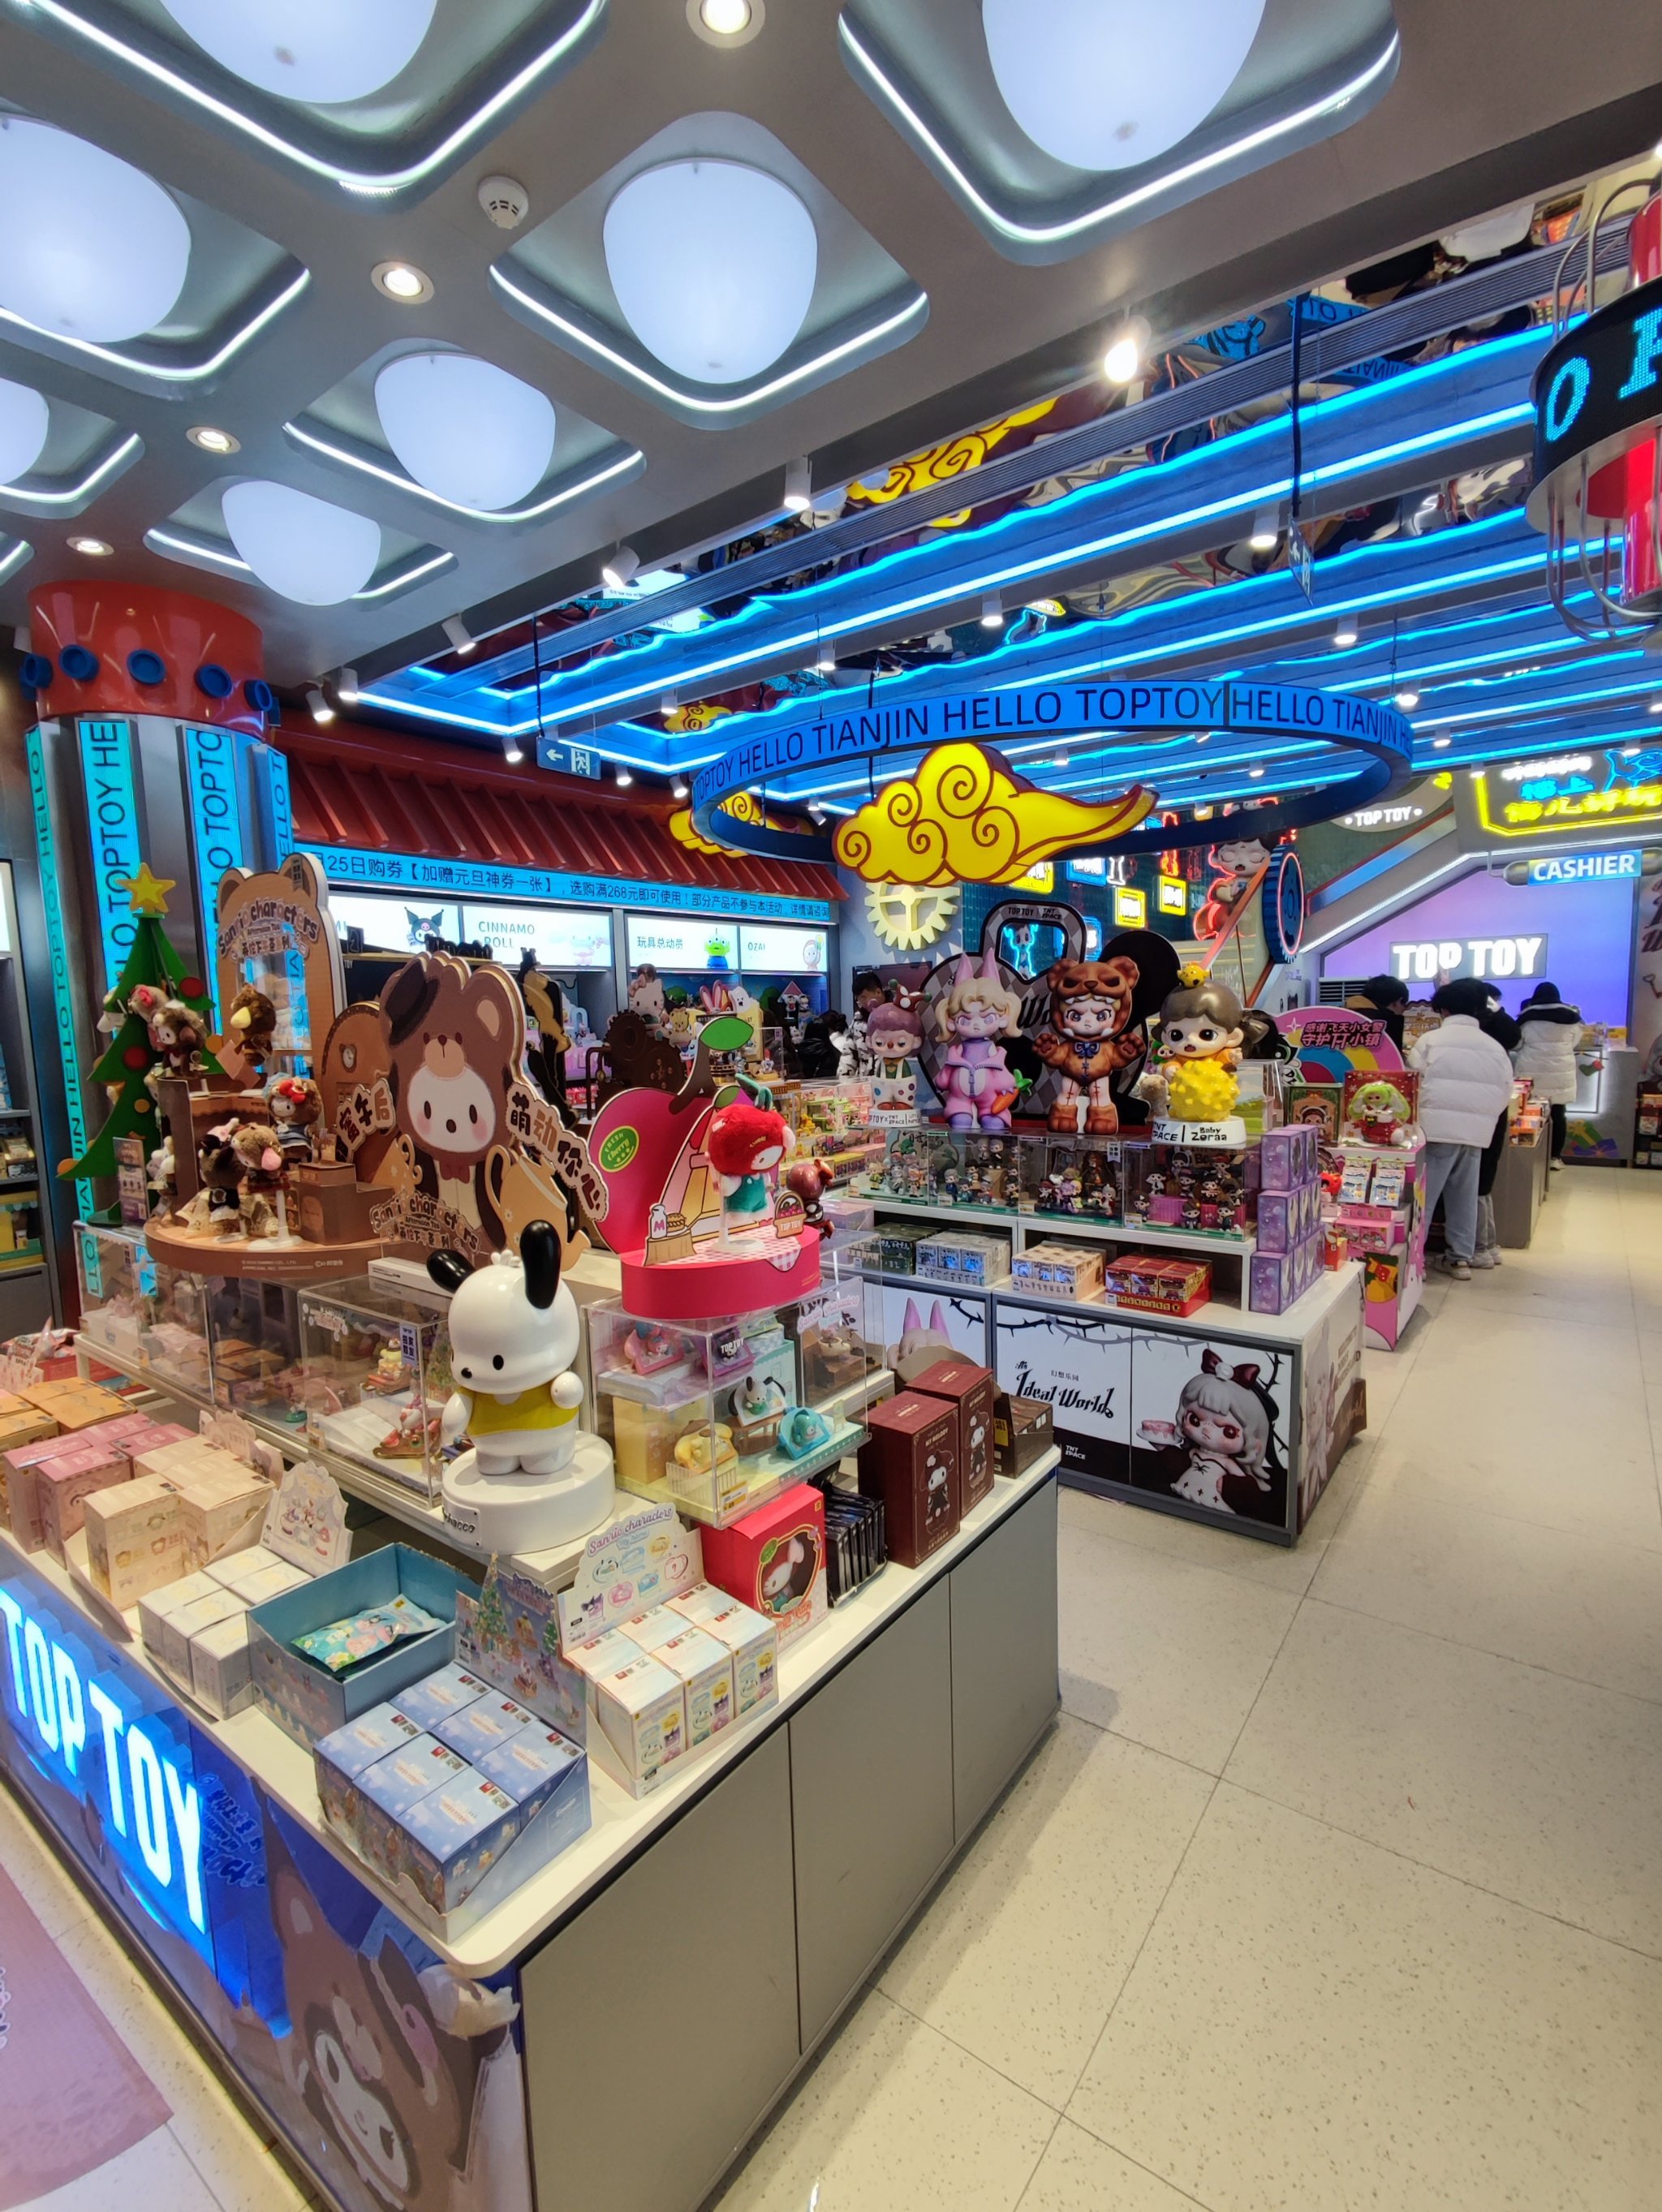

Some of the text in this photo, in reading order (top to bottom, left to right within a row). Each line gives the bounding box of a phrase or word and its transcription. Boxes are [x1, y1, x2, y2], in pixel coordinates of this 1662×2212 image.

[695, 756, 734, 801] TOPTOY
[738, 732, 803, 777] HELLO
[812, 705, 928, 755] TIANJIN
[944, 692, 1061, 730] HELLO
[1076, 687, 1221, 721] TOPTOY
[1232, 689, 1324, 725] HELLO
[1333, 699, 1397, 747] TIANJIN
[31, 750, 50, 857] HELLO
[1354, 805, 1412, 827] TOP TOY
[274, 784, 290, 860] ELLO
[95, 778, 131, 914] TOPTOY
[1533, 854, 1635, 881] CASHIER
[251, 900, 318, 940] characters
[1008, 906, 1034, 916] TOP TOY
[41, 870, 69, 996] TOPTOY
[479, 920, 536, 936] CINNAMO
[637, 936, 683, 950] 玩具总动员
[1393, 937, 1543, 980] TOP TOY
[1305, 1022, 1384, 1033] 感谢飞天小女警
[59, 1005, 79, 1106] HELLO
[1152, 1130, 1178, 1142] PACE
[1199, 1126, 1221, 1135] Baby
[607, 1138, 631, 1162] Cherry
[409, 1193, 479, 1250] characters
[780, 1219, 801, 1231] TOP TOY
[721, 1337, 744, 1354] TOP TOY
[1050, 1369, 1079, 1382] 幻想乐园
[1016, 1368, 1116, 1418] Ideal World
[1065, 1450, 1086, 1460] SPACE
[1066, 1444, 1079, 1453] TNT
[589, 1526, 622, 1556] Sanrio
[624, 1507, 674, 1533] characters
[0, 1588, 205, 1934] TOP TOY
